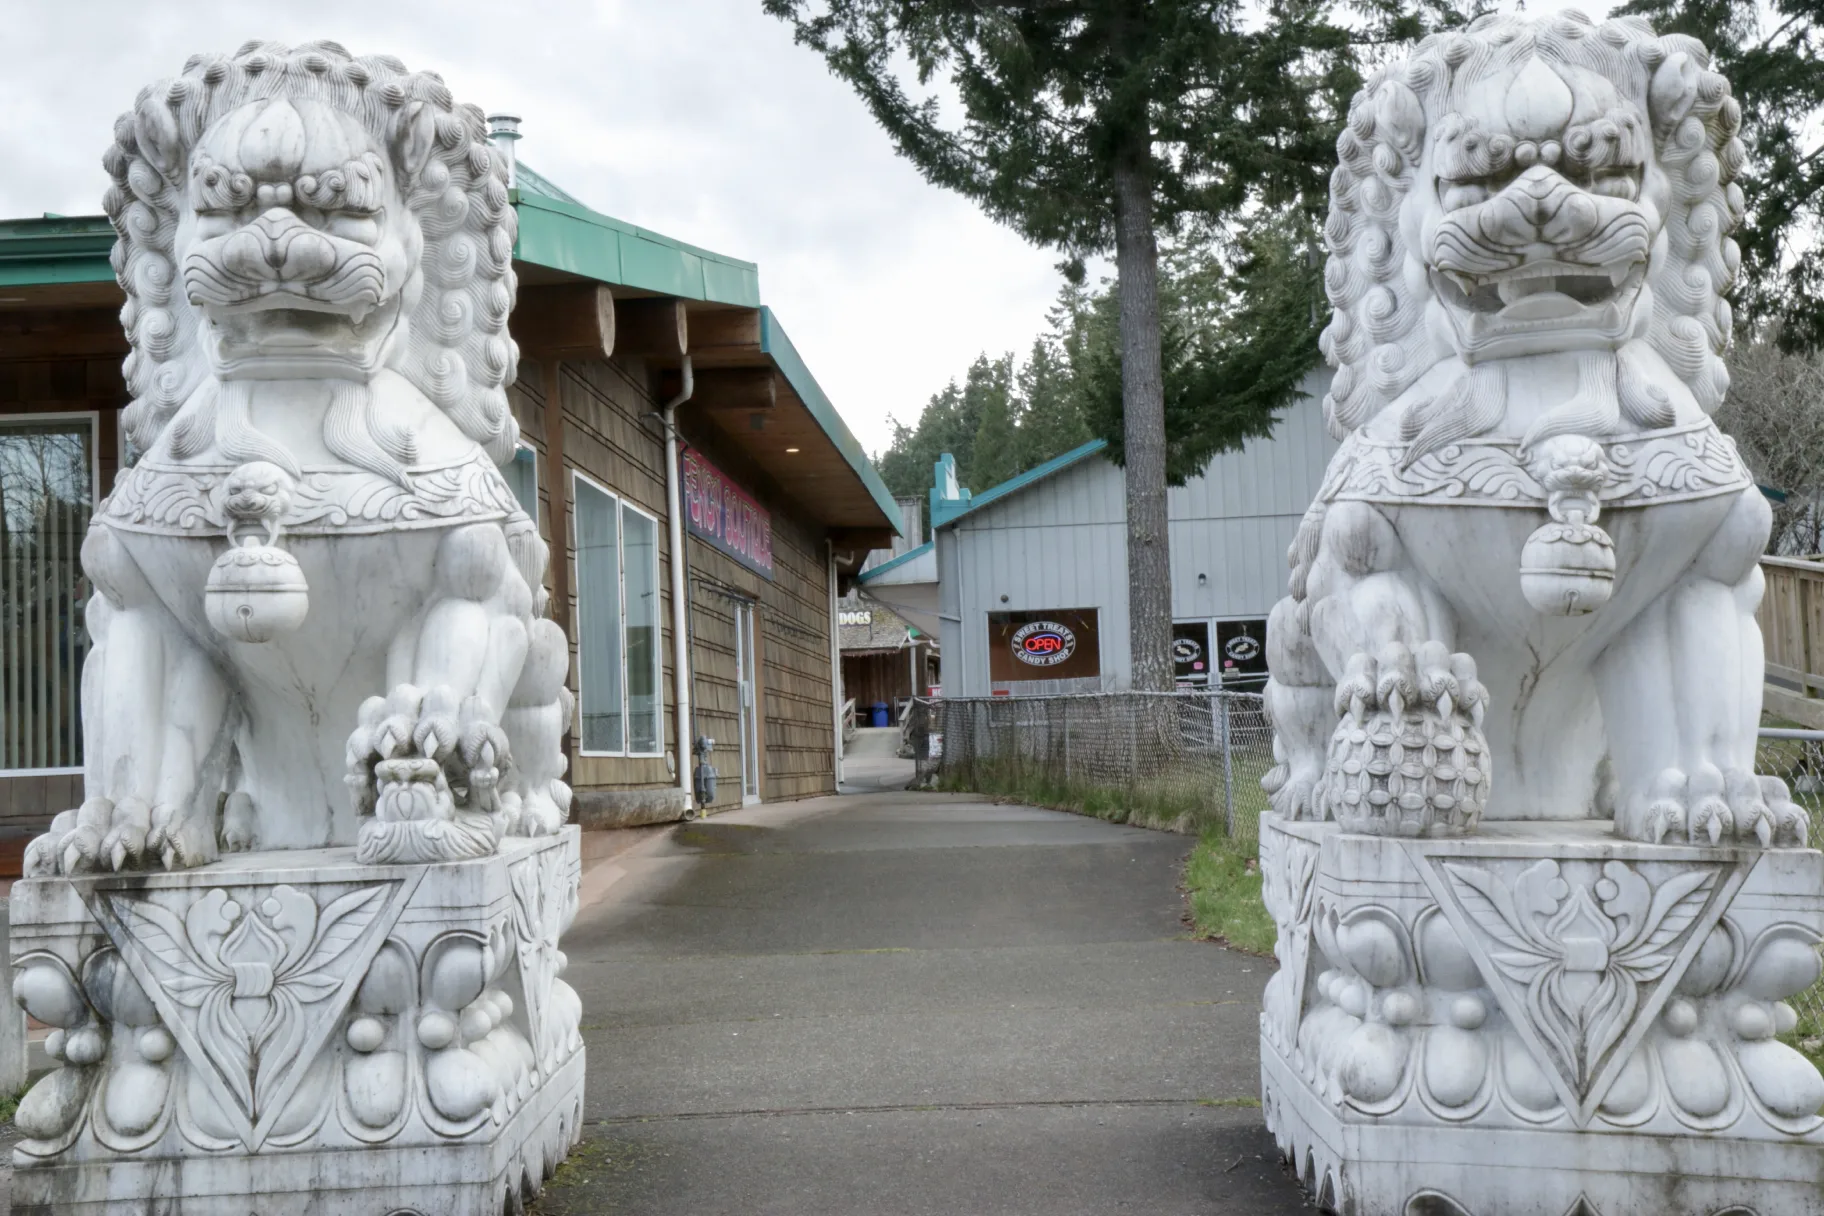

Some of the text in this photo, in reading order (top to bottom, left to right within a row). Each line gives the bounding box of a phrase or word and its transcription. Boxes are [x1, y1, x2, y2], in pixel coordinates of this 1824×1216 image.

[724, 485, 773, 570] BOUTIQUE
[839, 611, 871, 625] DOGS
[1014, 623, 1073, 641] SWEET TREATS
[1025, 638, 1061, 650] OPEN
[1017, 649, 1069, 664] CANDY SHOP
